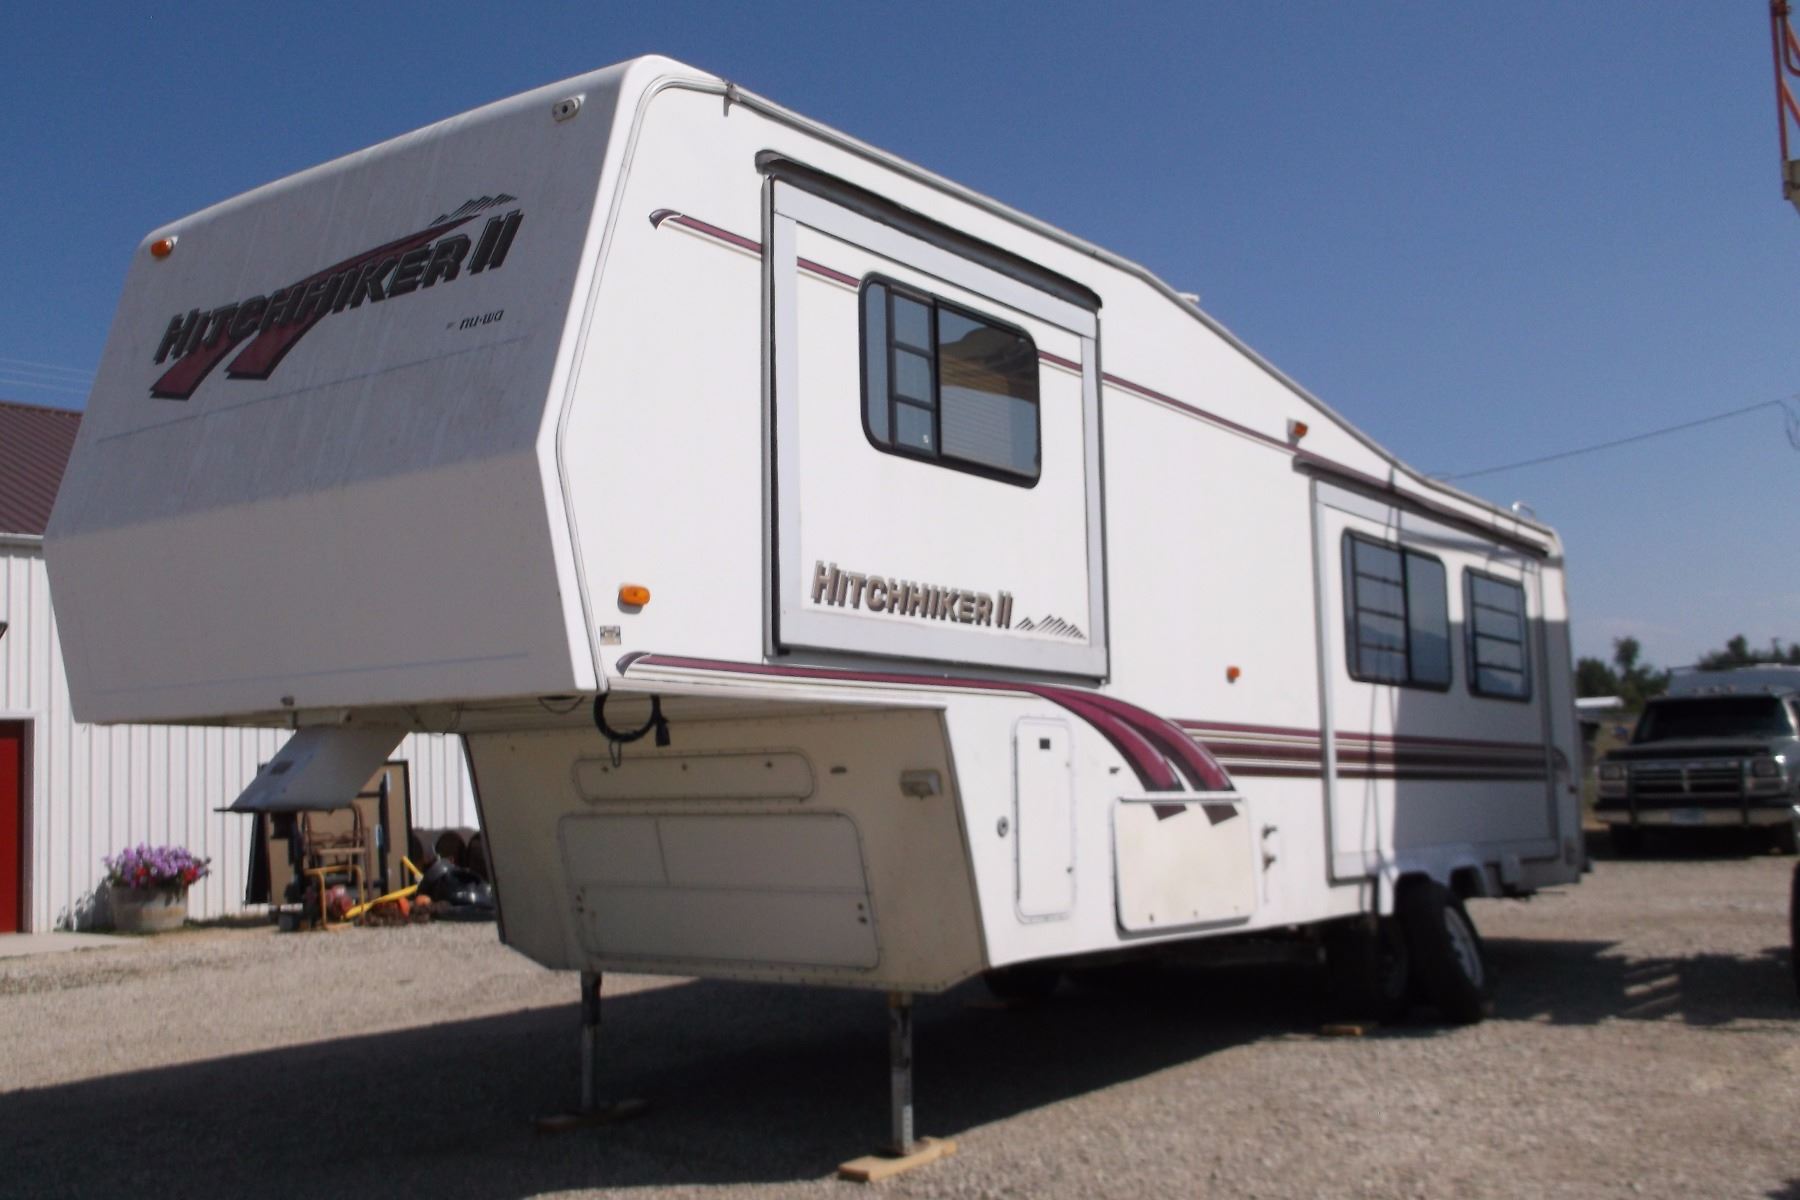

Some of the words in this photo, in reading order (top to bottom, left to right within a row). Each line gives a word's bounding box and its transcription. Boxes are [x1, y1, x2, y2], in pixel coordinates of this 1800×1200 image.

[154, 232, 472, 365] HITCHHIKER
[466, 209, 523, 274] II
[811, 560, 993, 627] HITCHHIKER
[996, 589, 1013, 629] II
